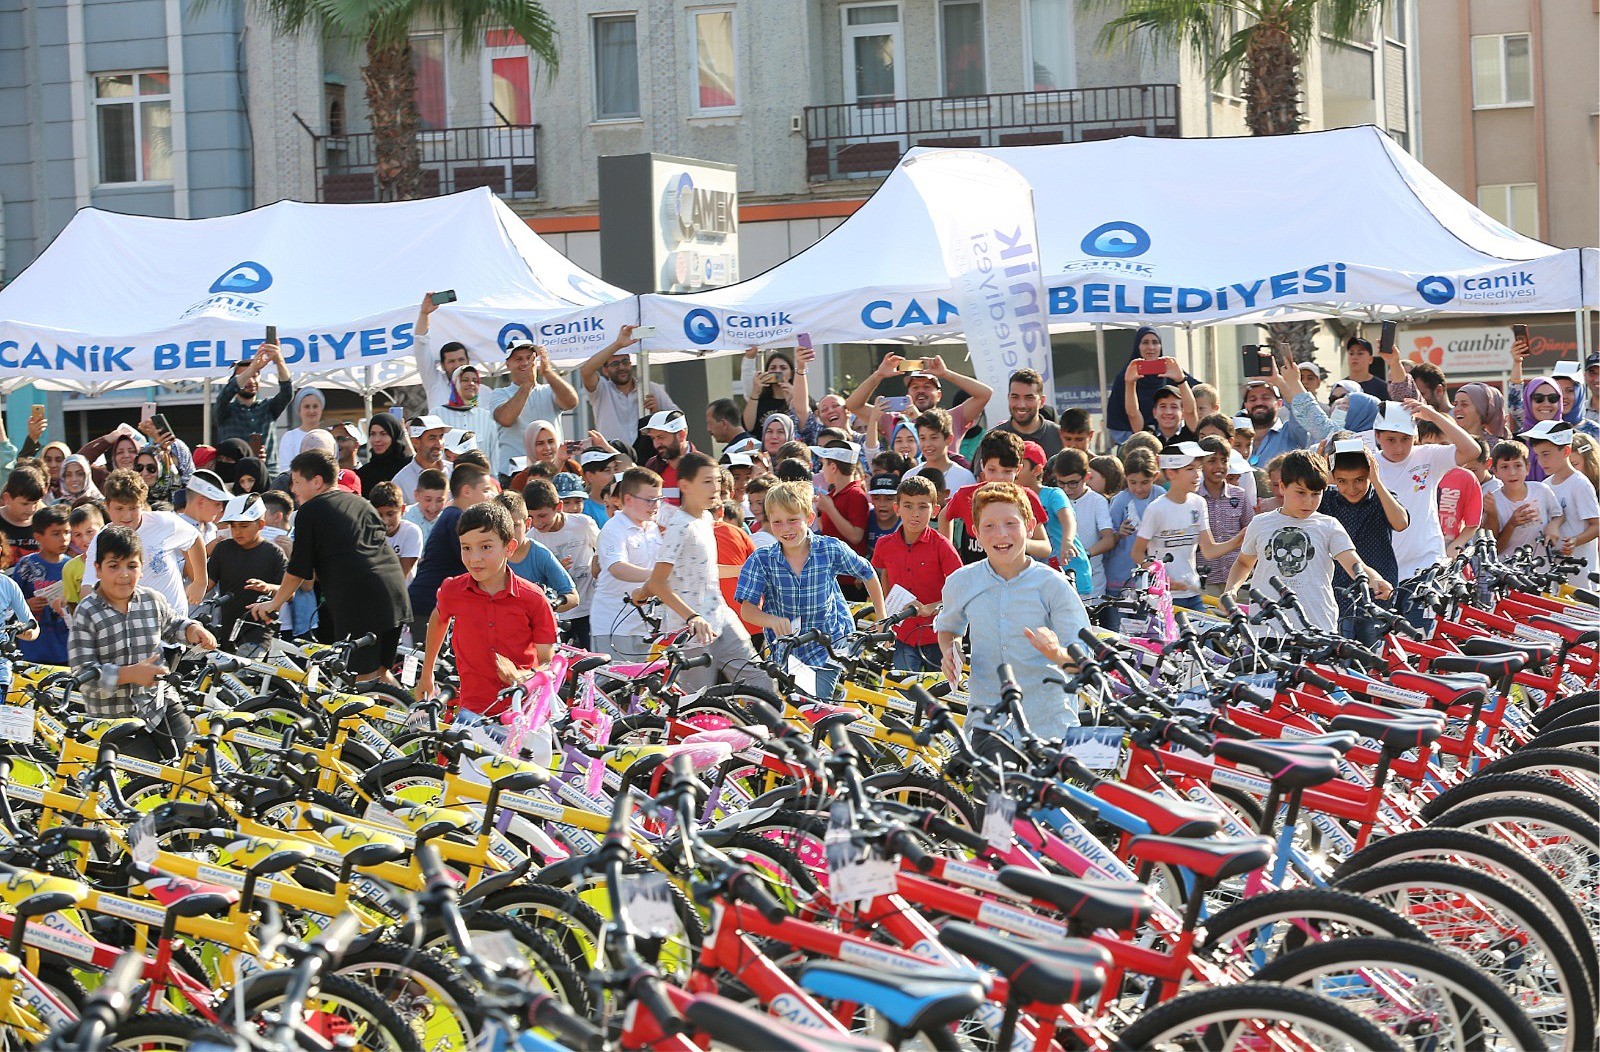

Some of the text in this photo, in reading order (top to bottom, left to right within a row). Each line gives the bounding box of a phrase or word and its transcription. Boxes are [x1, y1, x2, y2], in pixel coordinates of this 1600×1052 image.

[1463, 271, 1535, 291] canik
[861, 263, 1347, 330] CAN BELEDİYESİ
[1464, 287, 1537, 300] belediyesi
[540, 316, 604, 337] canik
[726, 311, 793, 329] canik
[541, 332, 605, 346] belediyesi
[727, 327, 793, 339] belediyesi
[1447, 333, 1510, 353] canbir
[0, 322, 414, 373] CANİK BELEDİYES
[221, 674, 243, 696] CANİK
[357, 725, 386, 751] CANİK
[1060, 822, 1107, 866] CANİK
